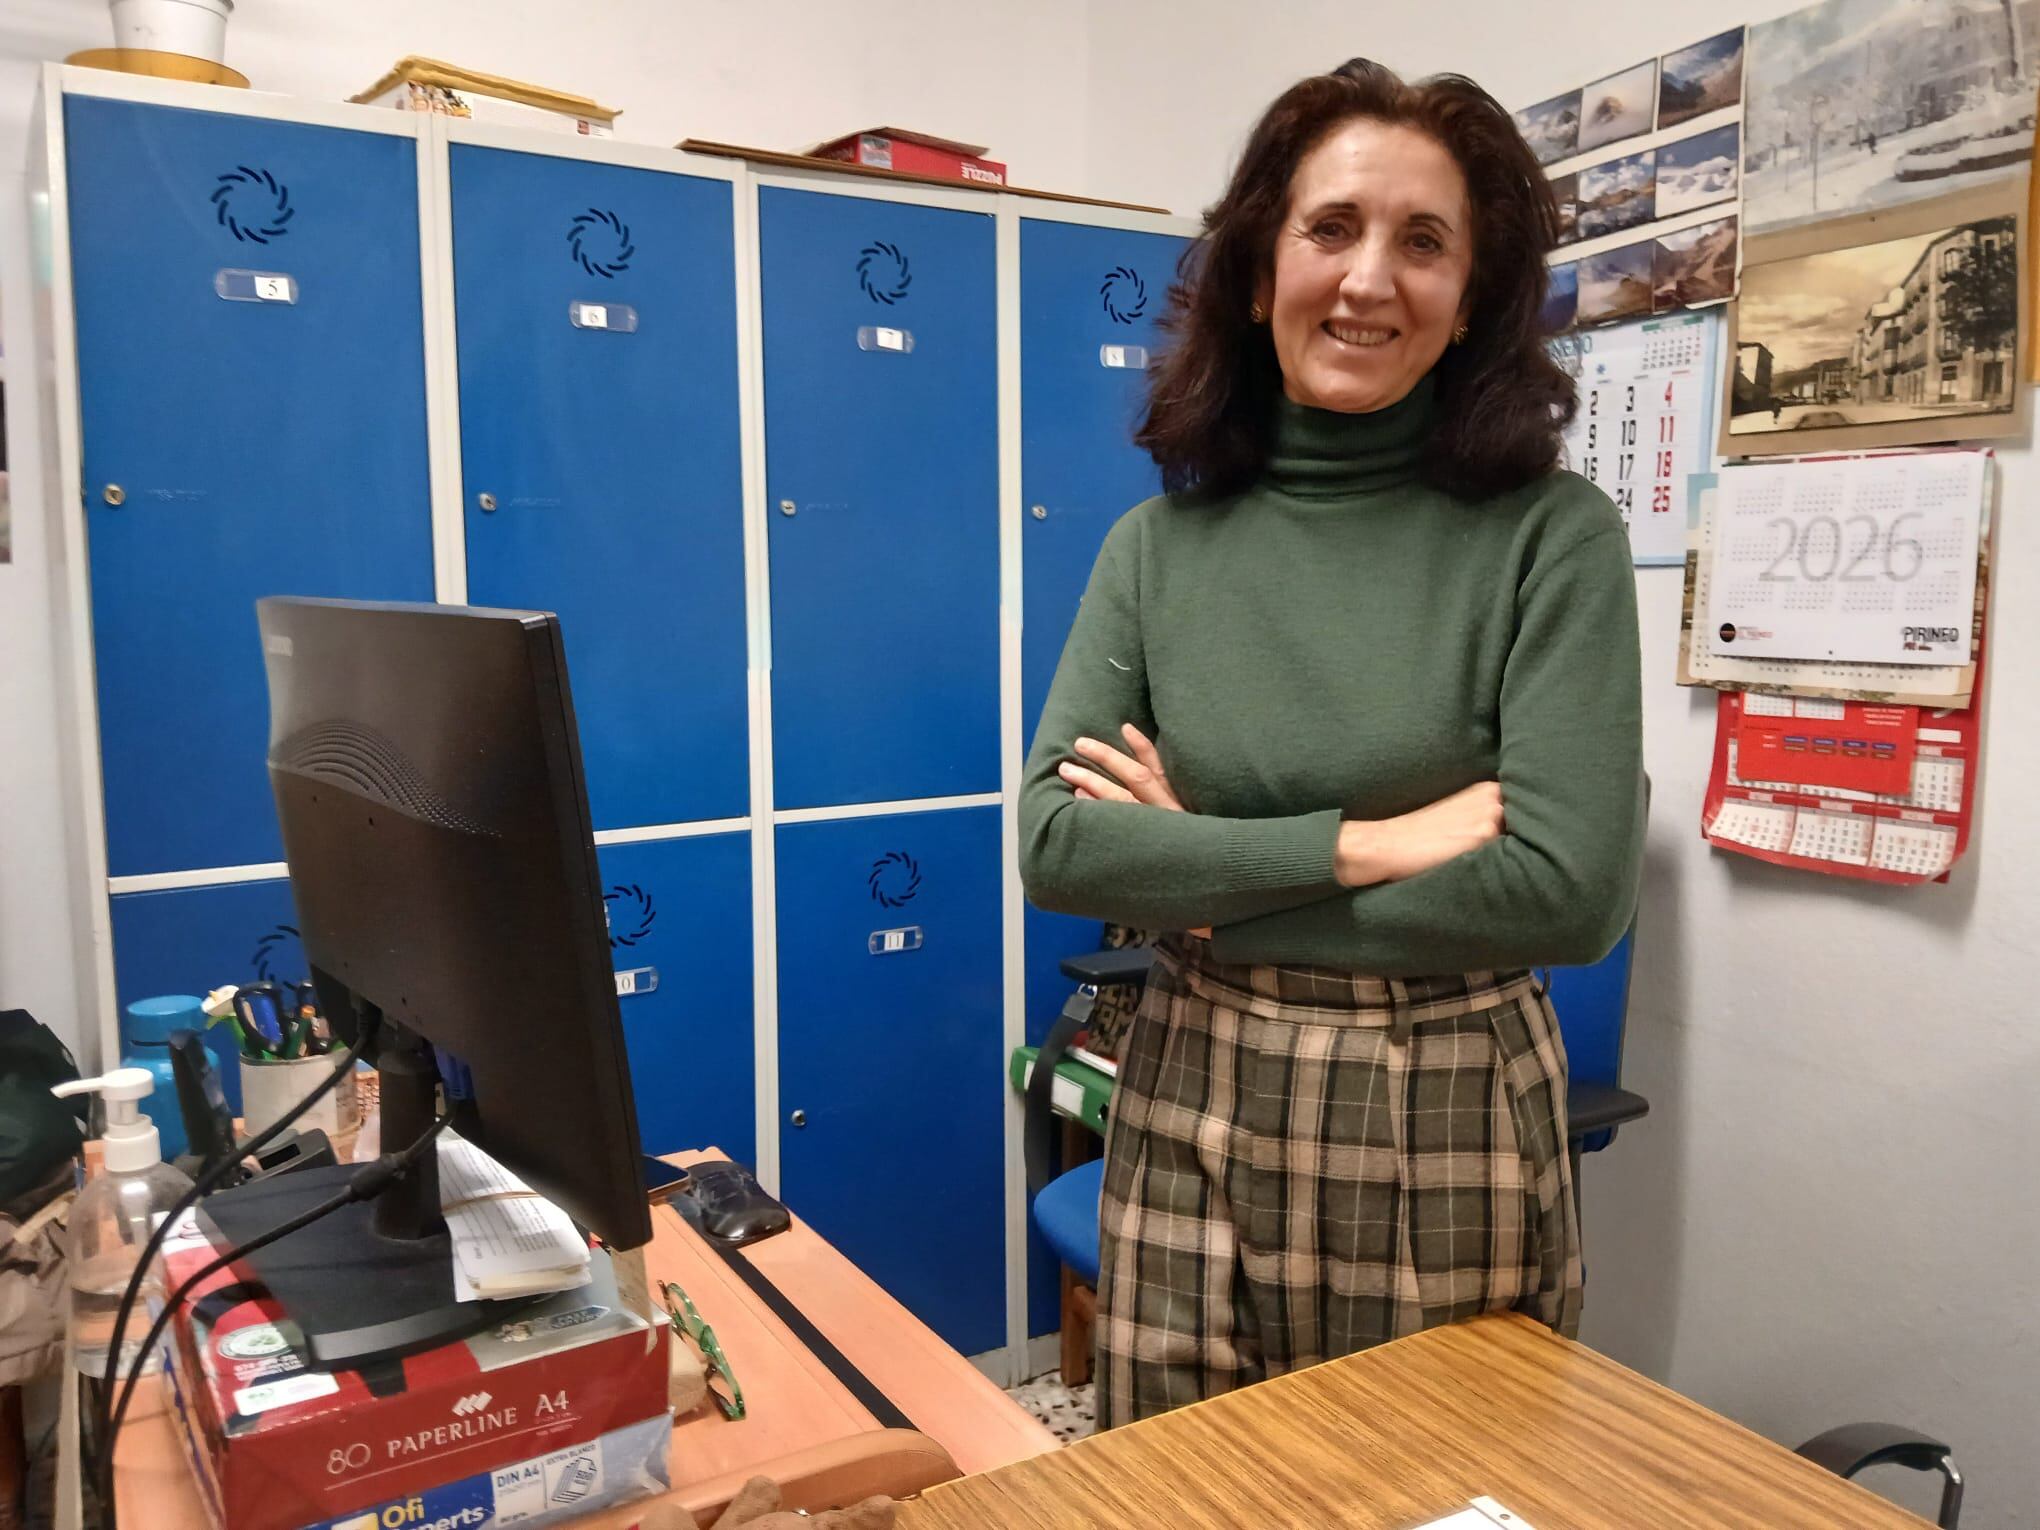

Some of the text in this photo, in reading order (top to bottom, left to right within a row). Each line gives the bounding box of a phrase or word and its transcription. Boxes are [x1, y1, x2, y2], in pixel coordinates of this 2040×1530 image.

[1590, 381, 1673, 416] 2 3 4
[1588, 416, 1674, 449] 9 10 11
[1583, 450, 1673, 482] 16 17 18
[1616, 485, 1671, 514] 24 25
[1757, 511, 1925, 583] 2026
[326, 1442, 372, 1475] 80
[387, 1406, 518, 1459] PAPERLINE
[534, 1389, 570, 1417] A4
[497, 1471, 520, 1488] DIN
[523, 1464, 540, 1478] A4
[382, 1497, 425, 1529] Ofi
